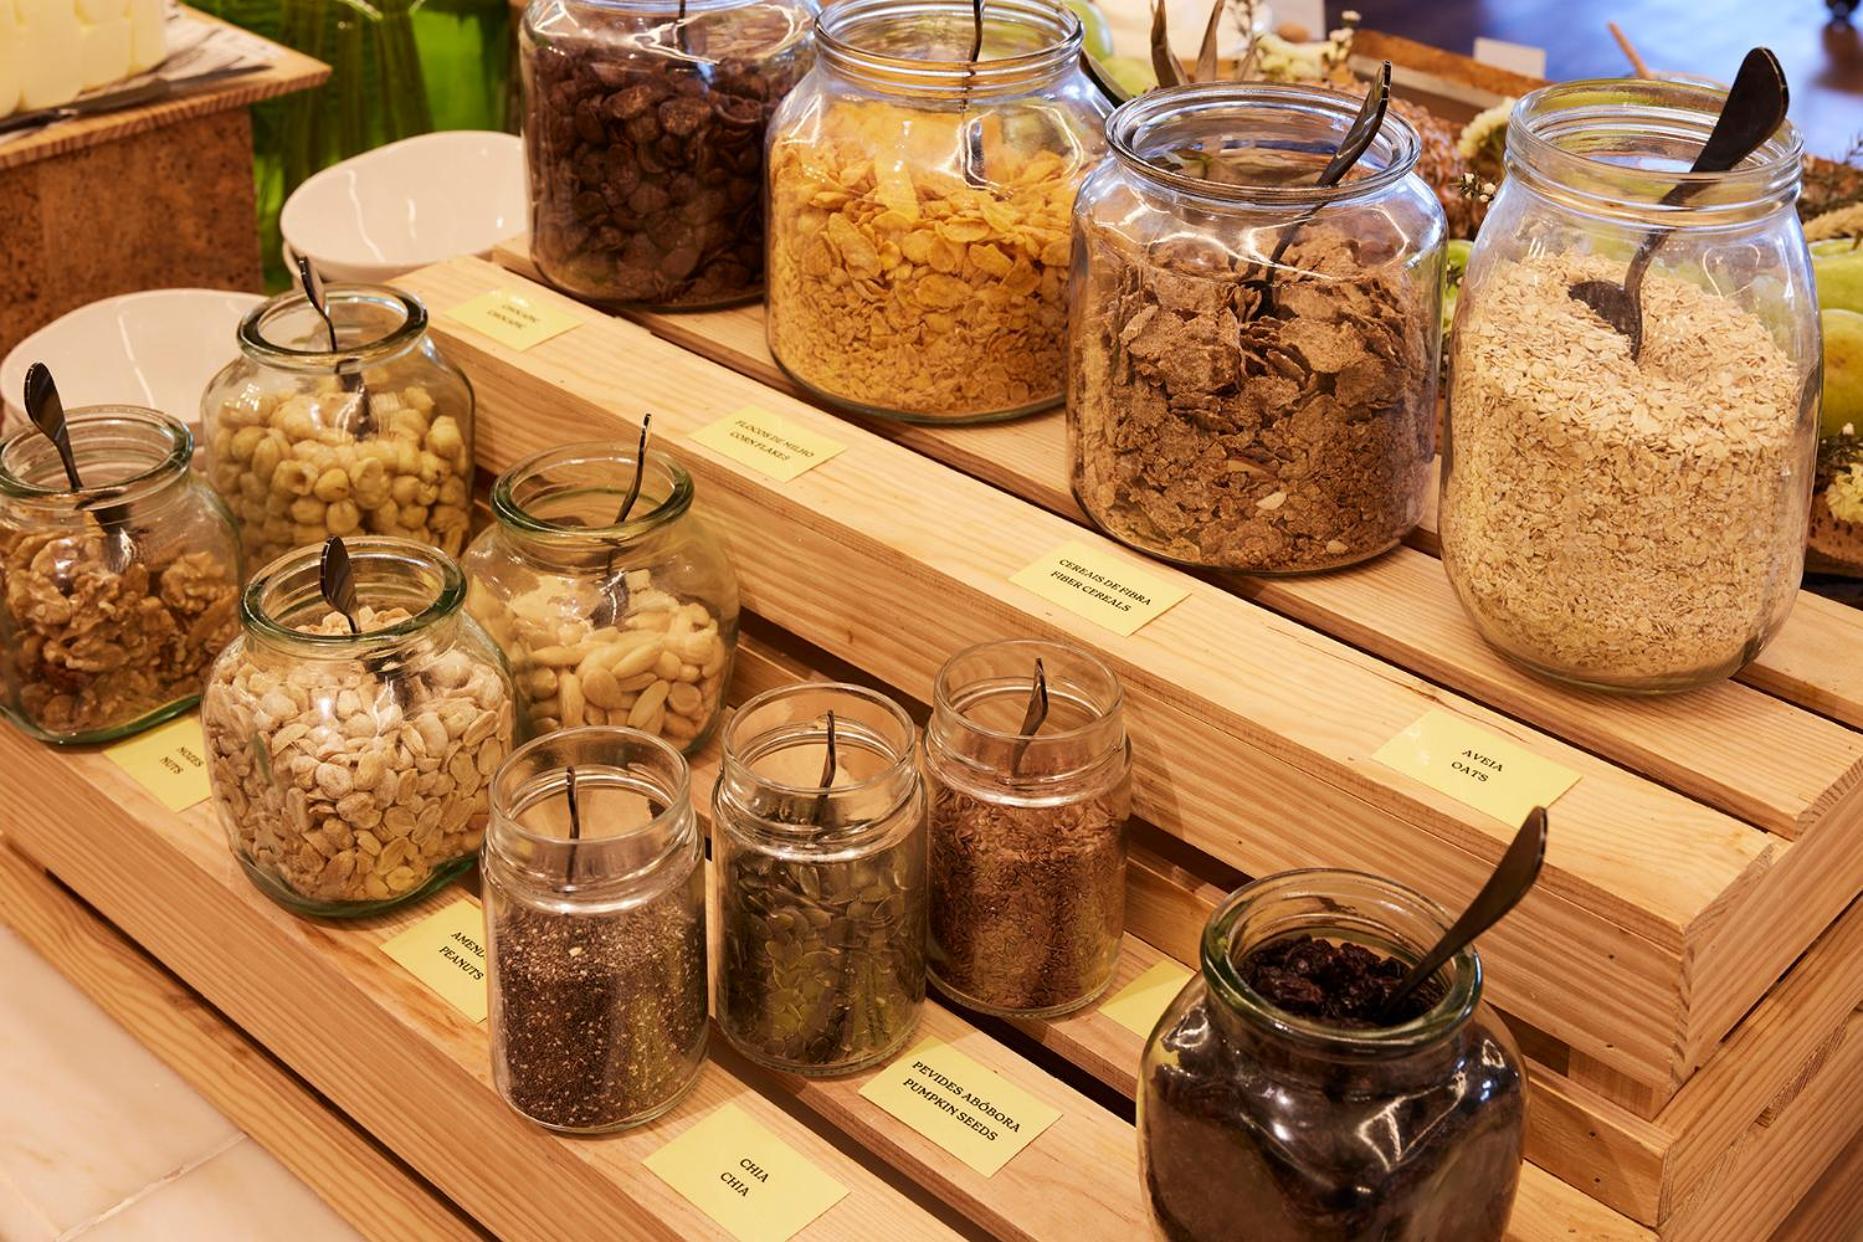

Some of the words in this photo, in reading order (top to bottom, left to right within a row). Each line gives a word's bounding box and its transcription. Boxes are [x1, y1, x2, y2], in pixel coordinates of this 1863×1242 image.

[1050, 570, 1084, 590] FIBER
[1082, 585, 1132, 612] CEREALS
[1059, 559, 1105, 584] CEREAIS
[1103, 579, 1121, 592] DE
[1119, 586, 1152, 606] FIBRA
[160, 756, 184, 774] NUTS
[1451, 761, 1489, 782] OATS
[1461, 749, 1503, 772] AVEIA
[439, 945, 484, 980] PEANUTS
[903, 1078, 959, 1116] PUMPKIN
[956, 1111, 998, 1141] SEEDS
[912, 1060, 964, 1096] PEVIDES
[961, 1092, 1021, 1133] ABÓBORA
[720, 1171, 749, 1197] CHIA
[739, 1158, 769, 1183] CHIA
